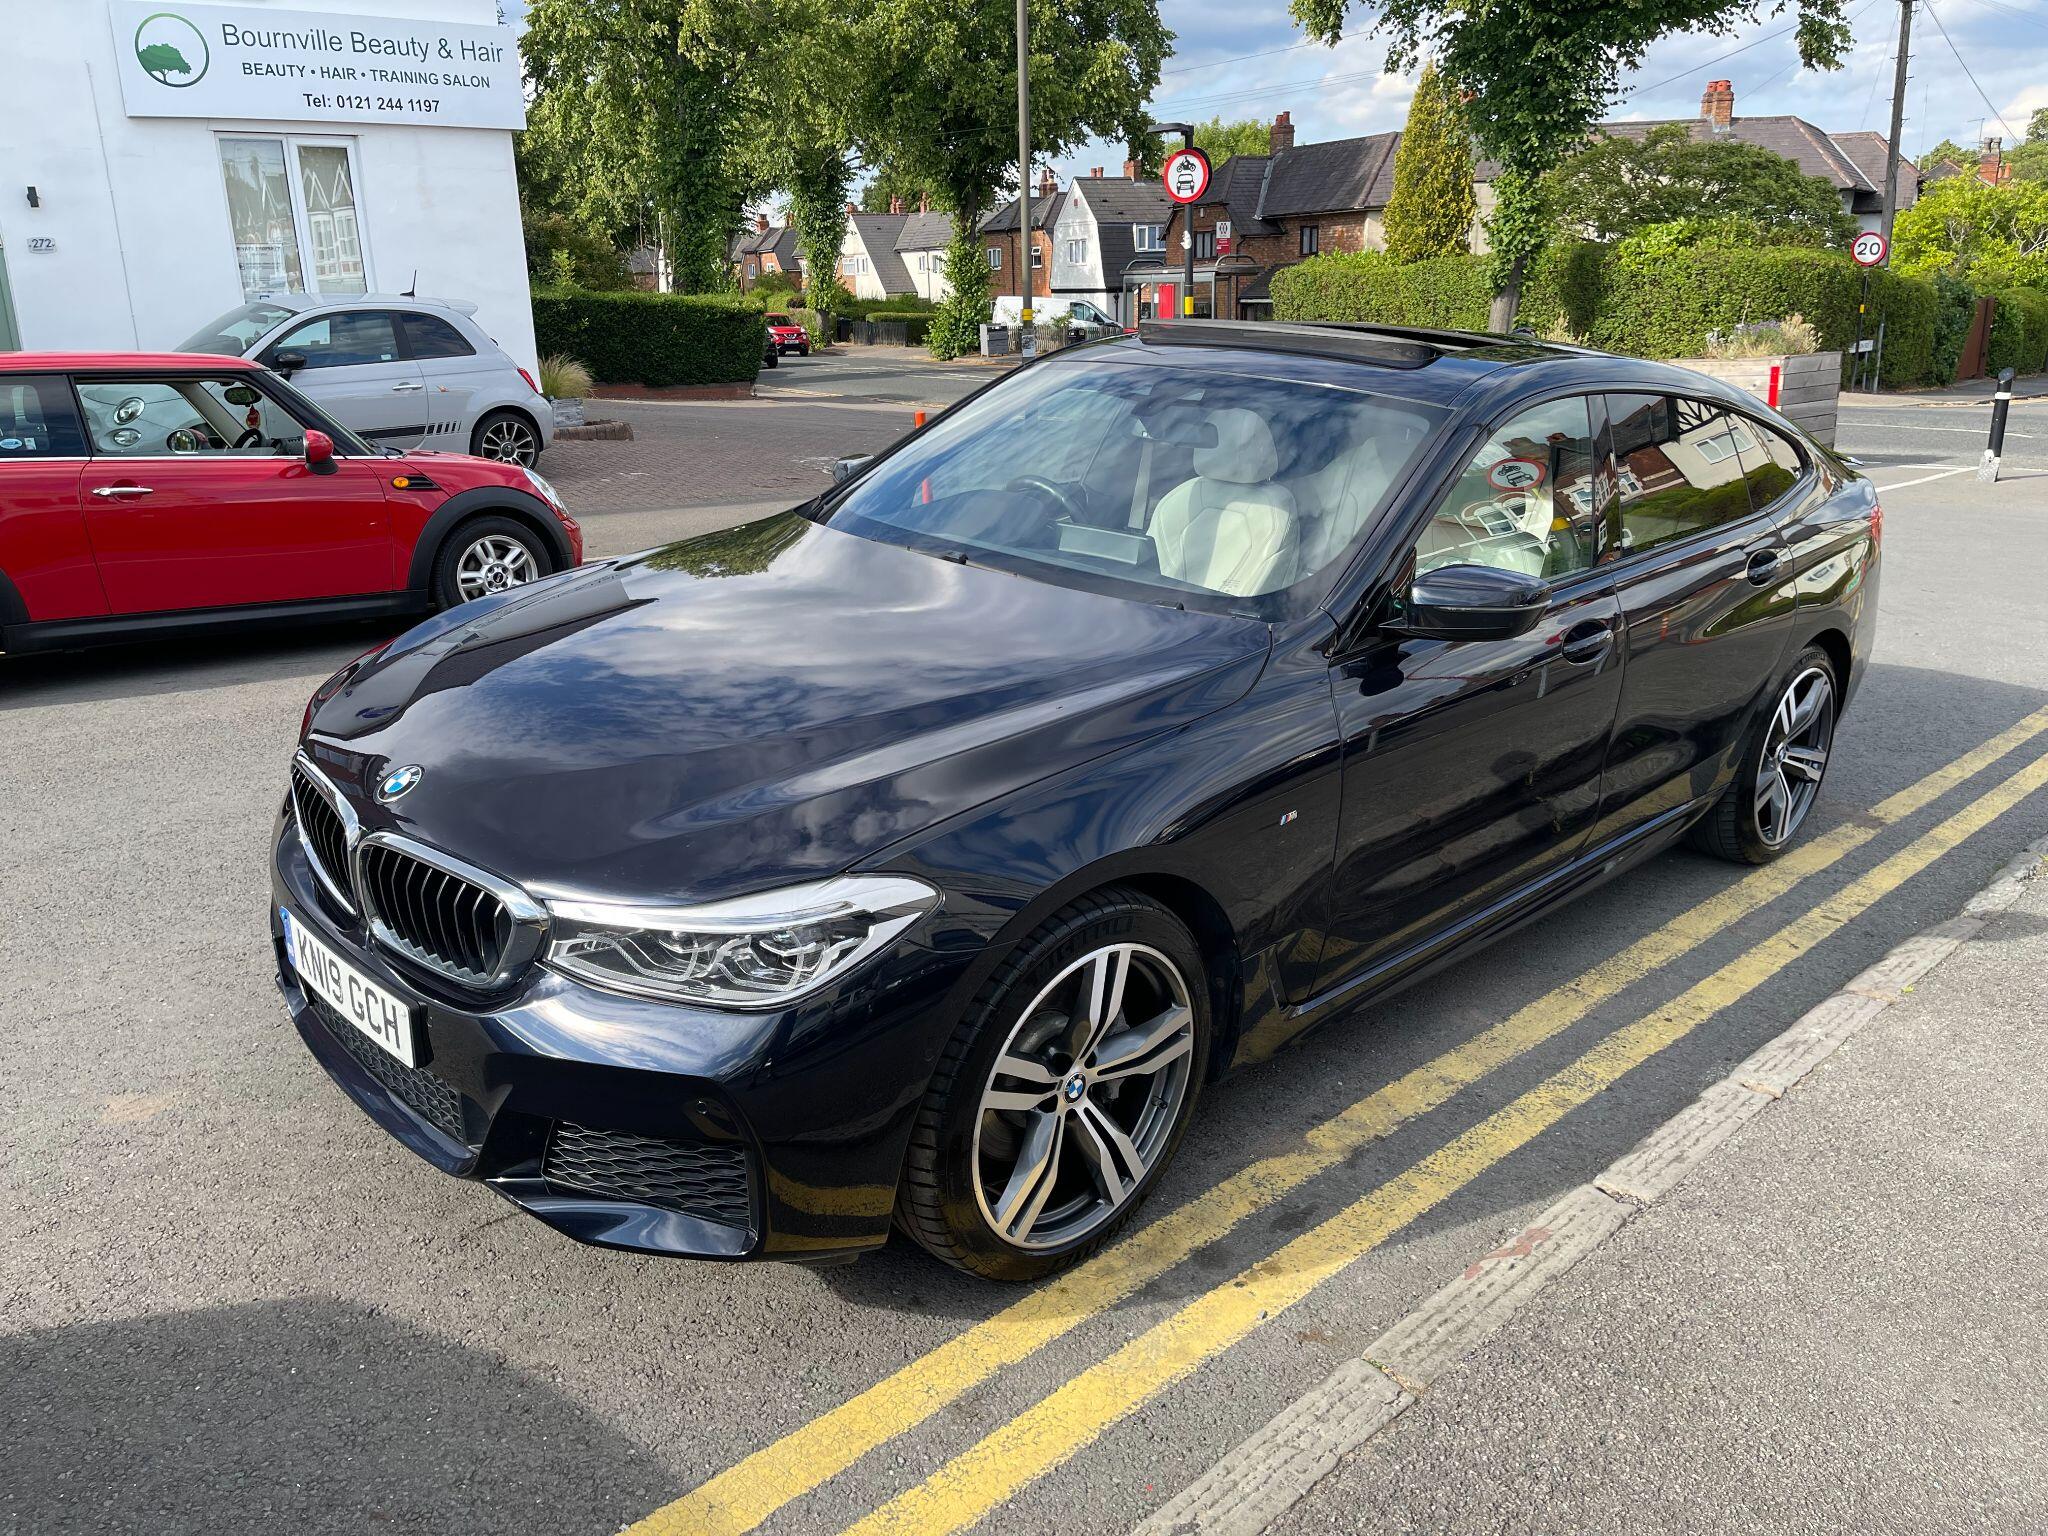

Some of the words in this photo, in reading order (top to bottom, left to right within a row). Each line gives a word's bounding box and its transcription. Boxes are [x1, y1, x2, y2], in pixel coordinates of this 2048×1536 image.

[222, 23, 342, 51] Bournville
[351, 31, 429, 63] Beauty
[438, 37, 454, 60] &
[460, 39, 503, 63] Hair
[242, 62, 306, 78] BEAUTY
[320, 66, 357, 80] HAIR
[370, 69, 439, 85] TRAINING
[443, 74, 491, 88] SALON
[303, 93, 331, 108] Tel:
[336, 95, 371, 110] 0121
[377, 97, 403, 111] 244
[408, 99, 439, 113] 1197
[31, 238, 52, 248] 272
[1857, 242, 1880, 256] 20
[297, 928, 344, 1005] KN19
[348, 974, 401, 1050] GCH
